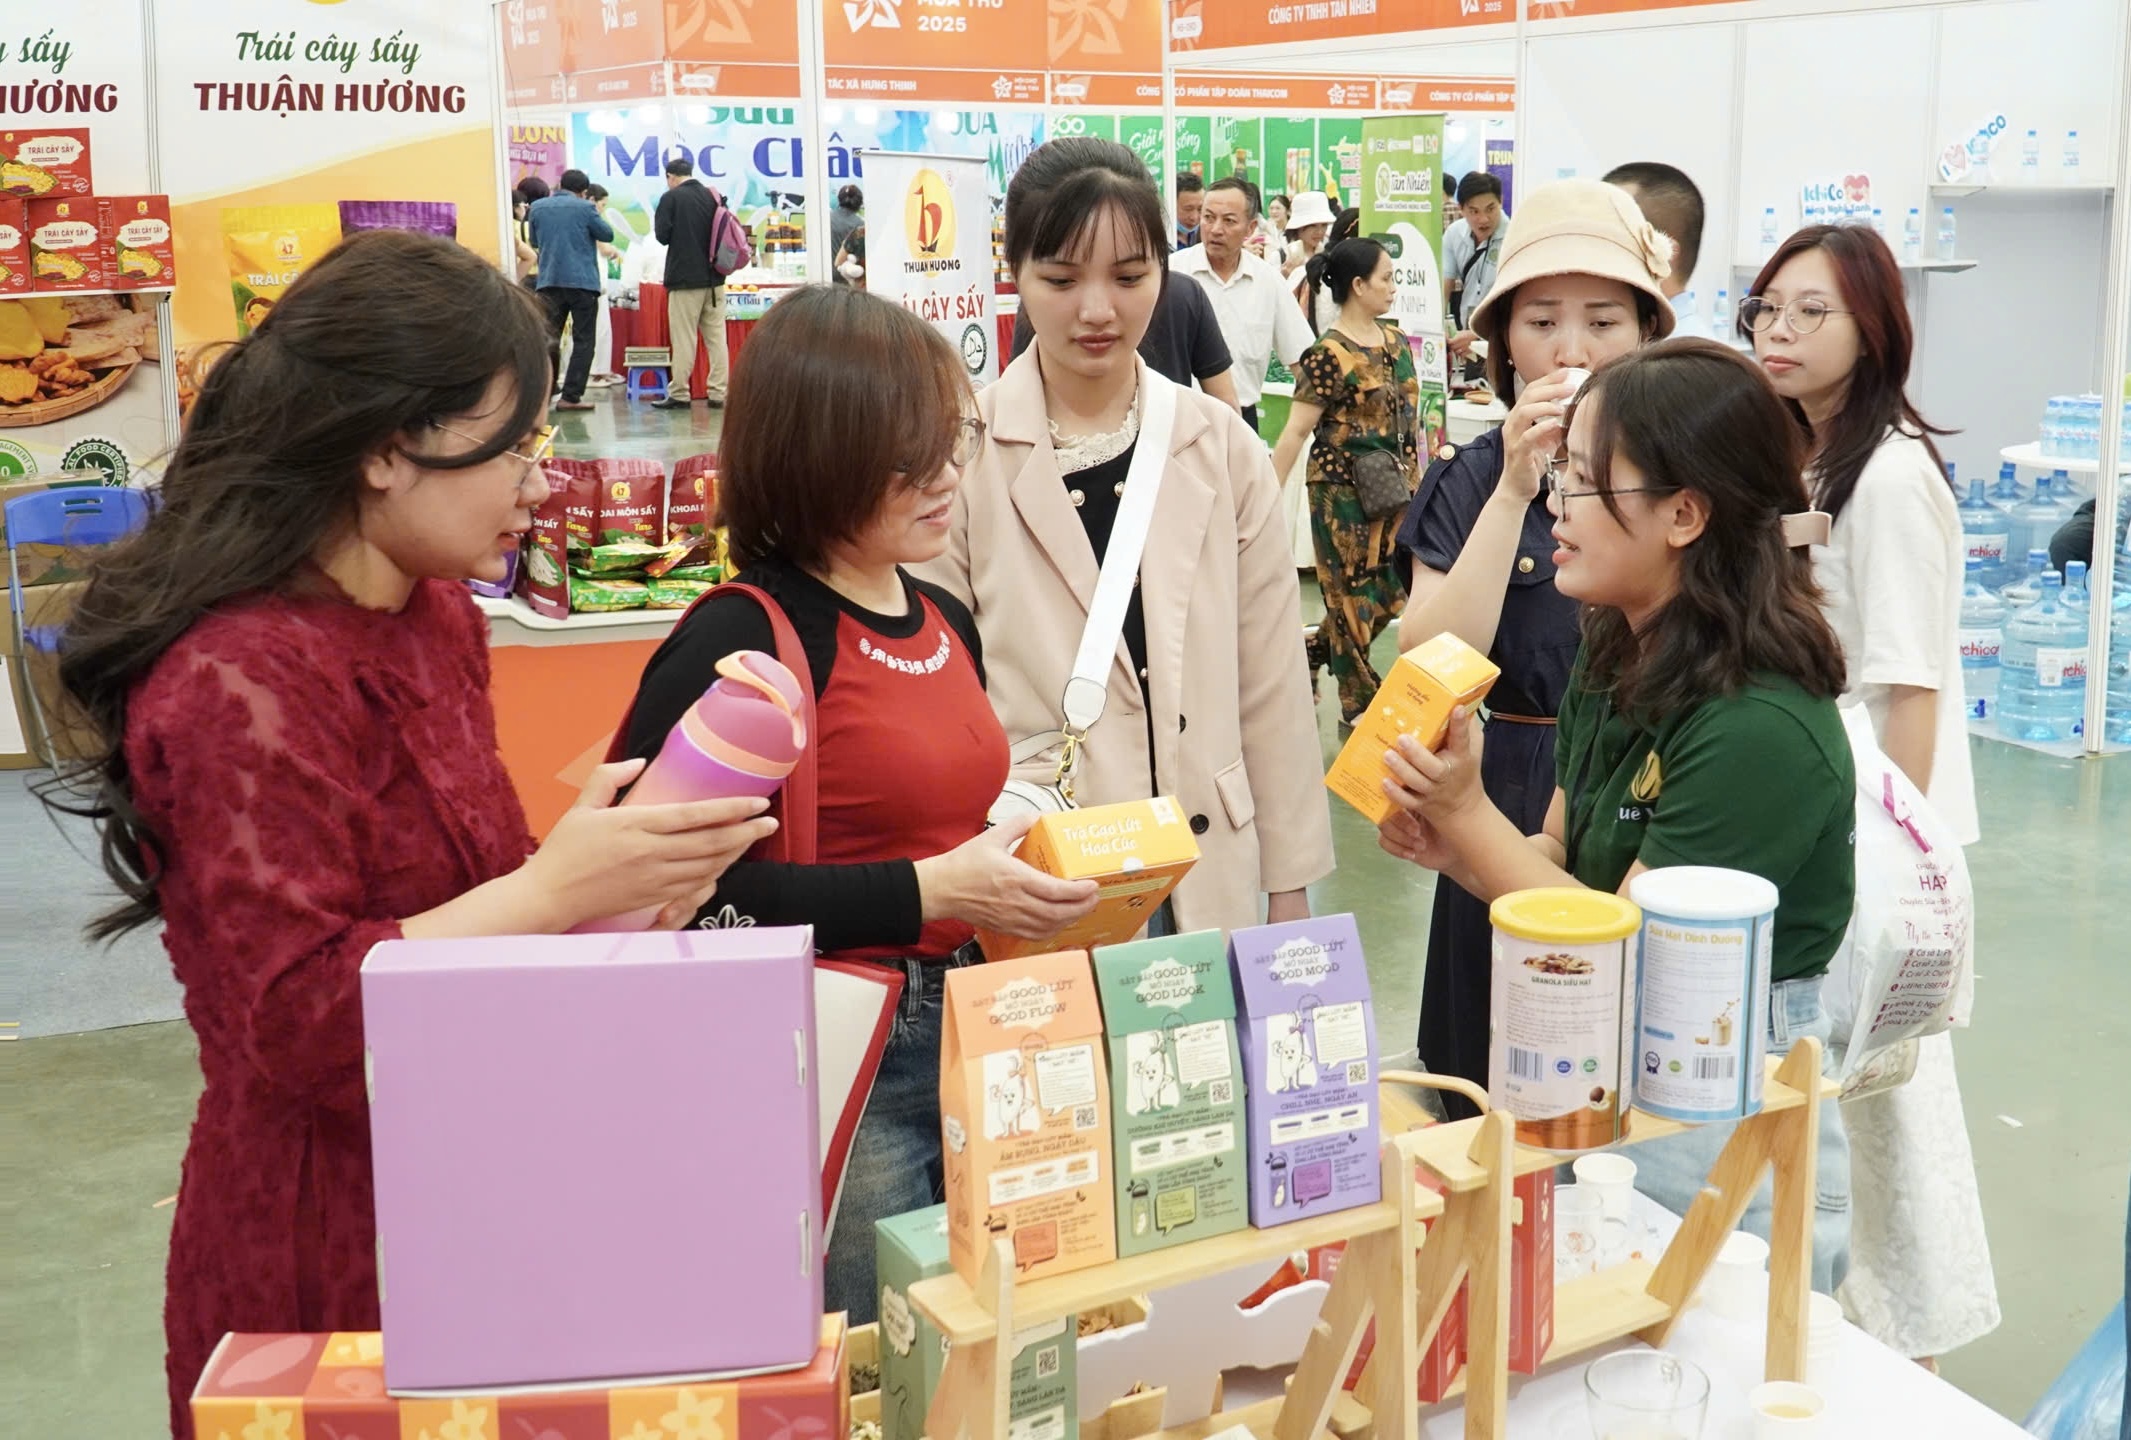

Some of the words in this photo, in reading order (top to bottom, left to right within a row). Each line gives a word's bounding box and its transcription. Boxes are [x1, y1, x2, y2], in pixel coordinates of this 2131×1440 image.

[1293, 5, 1304, 22] TY
[918, 16, 967, 32] 2025
[18, 28, 73, 74] sấy
[236, 30, 296, 62] Trái
[304, 34, 361, 73] cây
[369, 28, 422, 74] sấy
[194, 74, 324, 118] THUẬN
[335, 78, 466, 114] HƯƠNG
[281, 272, 299, 285] CÂ
[922, 291, 950, 321] CÂY
[956, 284, 984, 320] SẤY
[1288, 945, 1320, 958] GOOD
[1154, 966, 1187, 979] GOOD
[1270, 968, 1302, 981] GOOD
[1306, 962, 1339, 976] MOOD
[1010, 985, 1046, 999] GOOD
[1136, 990, 1170, 1003] GOOD
[1173, 984, 1205, 998] LOOK
[989, 1010, 1027, 1024] GOOD
[1030, 1002, 1066, 1018] FLOW
